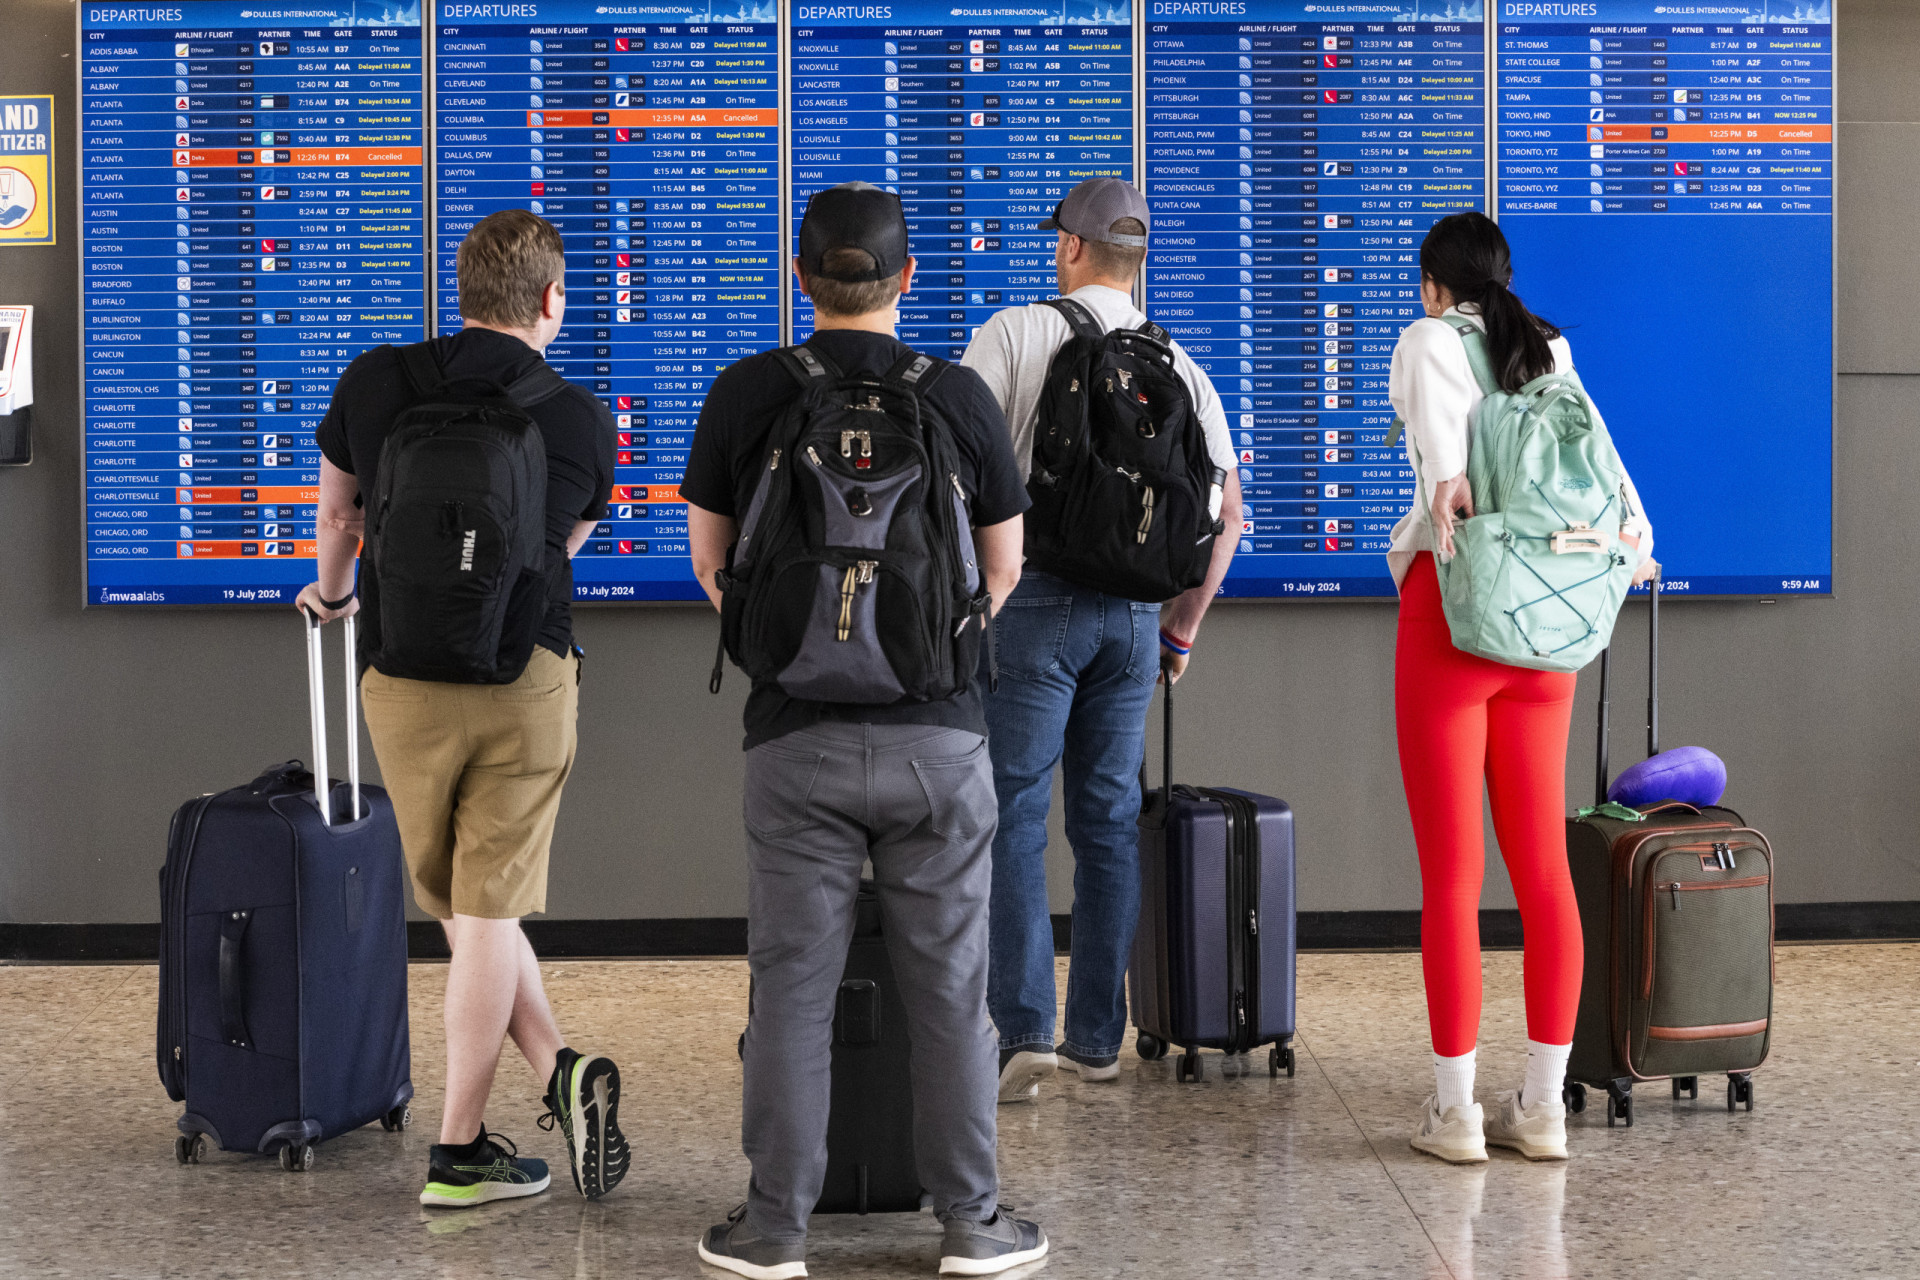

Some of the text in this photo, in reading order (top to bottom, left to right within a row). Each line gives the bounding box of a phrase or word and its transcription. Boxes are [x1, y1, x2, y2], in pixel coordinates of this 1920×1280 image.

[445, 5, 537, 17] DEPARTURES
[609, 6, 693, 15] DULLES INTERNATIONAL
[800, 7, 891, 18] DEPARTURES
[963, 8, 1048, 16] DULLES INTERNATIONAL
[1154, 3, 1245, 14] DEPARTURES
[1317, 5, 1400, 13] DULLES INTERNATIONAL
[1506, 4, 1596, 15] DEPARTURES
[1667, 6, 1749, 15] DULLES INTERNATIONAL
[91, 9, 182, 21] DEPARTURES
[253, 10, 337, 19] DULLES INTERNATIONAL
[1239, 25, 1296, 33] AIRLINE FLIGHT
[90, 32, 104, 40] CITY
[175, 31, 202, 39] AIRLINE
[210, 31, 233, 39] FLIGHT
[259, 30, 290, 38] PARTNER
[304, 30, 320, 38] TIME
[371, 29, 397, 37] STATUS
[444, 43, 486, 51] CINCINNATI
[654, 42, 669, 50] 8:30
[670, 41, 682, 49] AM
[691, 41, 705, 50] D29
[714, 41, 738, 50] Delayed
[799, 44, 1059, 53] KNOXVILLE 8:45 AM A4E
[1153, 40, 1184, 48] OTTAWA
[90, 47, 112, 56] ADDIS
[113, 47, 138, 56] ABABA
[297, 45, 314, 54] 10:55
[316, 45, 328, 53] AM
[335, 45, 348, 53] B37
[370, 45, 380, 53] On
[382, 45, 399, 53] Time
[1154, 58, 1392, 67] PHILADELPHIA 12:45 PM
[1506, 58, 1560, 66] STATE COLLEGE
[90, 65, 118, 73] ALBANY
[298, 63, 313, 71] 8:45
[314, 63, 326, 71] AM
[335, 63, 350, 71] A4A
[358, 63, 382, 72] Delayed
[1154, 76, 1186, 84] PHOENIX
[1506, 75, 1541, 84] SYRACUSE
[799, 81, 840, 89] LANCASTER
[1007, 80, 1025, 88] 12:40
[1026, 80, 1039, 88] PM
[1046, 80, 1060, 88] H17
[445, 96, 755, 106] CLEVELAND 12:45 PM A2B On Time
[799, 98, 847, 107] LOS ANGELES
[1154, 94, 1198, 102] PITTSBURGH
[0, 105, 38, 130] ND
[445, 115, 484, 124] COLUMBIA
[1506, 111, 1550, 120] TOKYO, HND
[445, 133, 487, 142] COLUMBUS
[800, 134, 1059, 144] LOUISVILLE C18
[1154, 131, 1214, 139] PORTLAND, PWM
[0, 134, 46, 150] TIZER
[445, 151, 492, 160] DALLAS, DFW
[1506, 148, 1558, 157] TORONTO, YTZ
[91, 155, 123, 163] ATLANTA
[297, 153, 315, 162] 12:26
[317, 153, 329, 161] PM
[336, 153, 349, 161] B74
[368, 152, 402, 161] Cancelled
[1154, 166, 1199, 174] PROVIDENCE
[800, 171, 822, 179] MIAMI
[445, 186, 466, 194] DELHI
[653, 184, 671, 193] 11:15
[673, 184, 685, 192] AM
[691, 184, 705, 192] B45
[445, 204, 473, 212] DENVER
[1154, 200, 1412, 209] PUNTA CANA 8:51 AM C17
[1506, 202, 1762, 210] WILKES-BARRE A6A
[1154, 219, 1184, 227] RALEIGH
[92, 243, 350, 253] BOSTON 8:37 AM D11
[1155, 255, 1196, 263] ROCHESTER
[92, 280, 132, 289] BRADFORD
[298, 279, 316, 287] 12:40
[318, 279, 330, 287] PM
[337, 278, 351, 286] H17
[371, 278, 382, 286] On
[384, 278, 401, 286] Time
[93, 315, 140, 324] BURLINGTON
[93, 349, 346, 359] CANCUN 8:33 AM D1
[93, 384, 329, 394] CHARLESTON, CHS 1:20 PM
[94, 421, 135, 430] CHARLOTTE
[95, 492, 159, 501] CHARLOTTESVILLE
[95, 528, 148, 537] CHICAGO, ORD
[460, 530, 476, 571] THULE
[1283, 583, 1340, 593] 19 July 2024
[1782, 580, 1819, 589] 9:59 AM
[110, 592, 164, 601] mwaalabs
[224, 590, 280, 600] 19 July 2024
[577, 587, 634, 597] 19 July 2024
